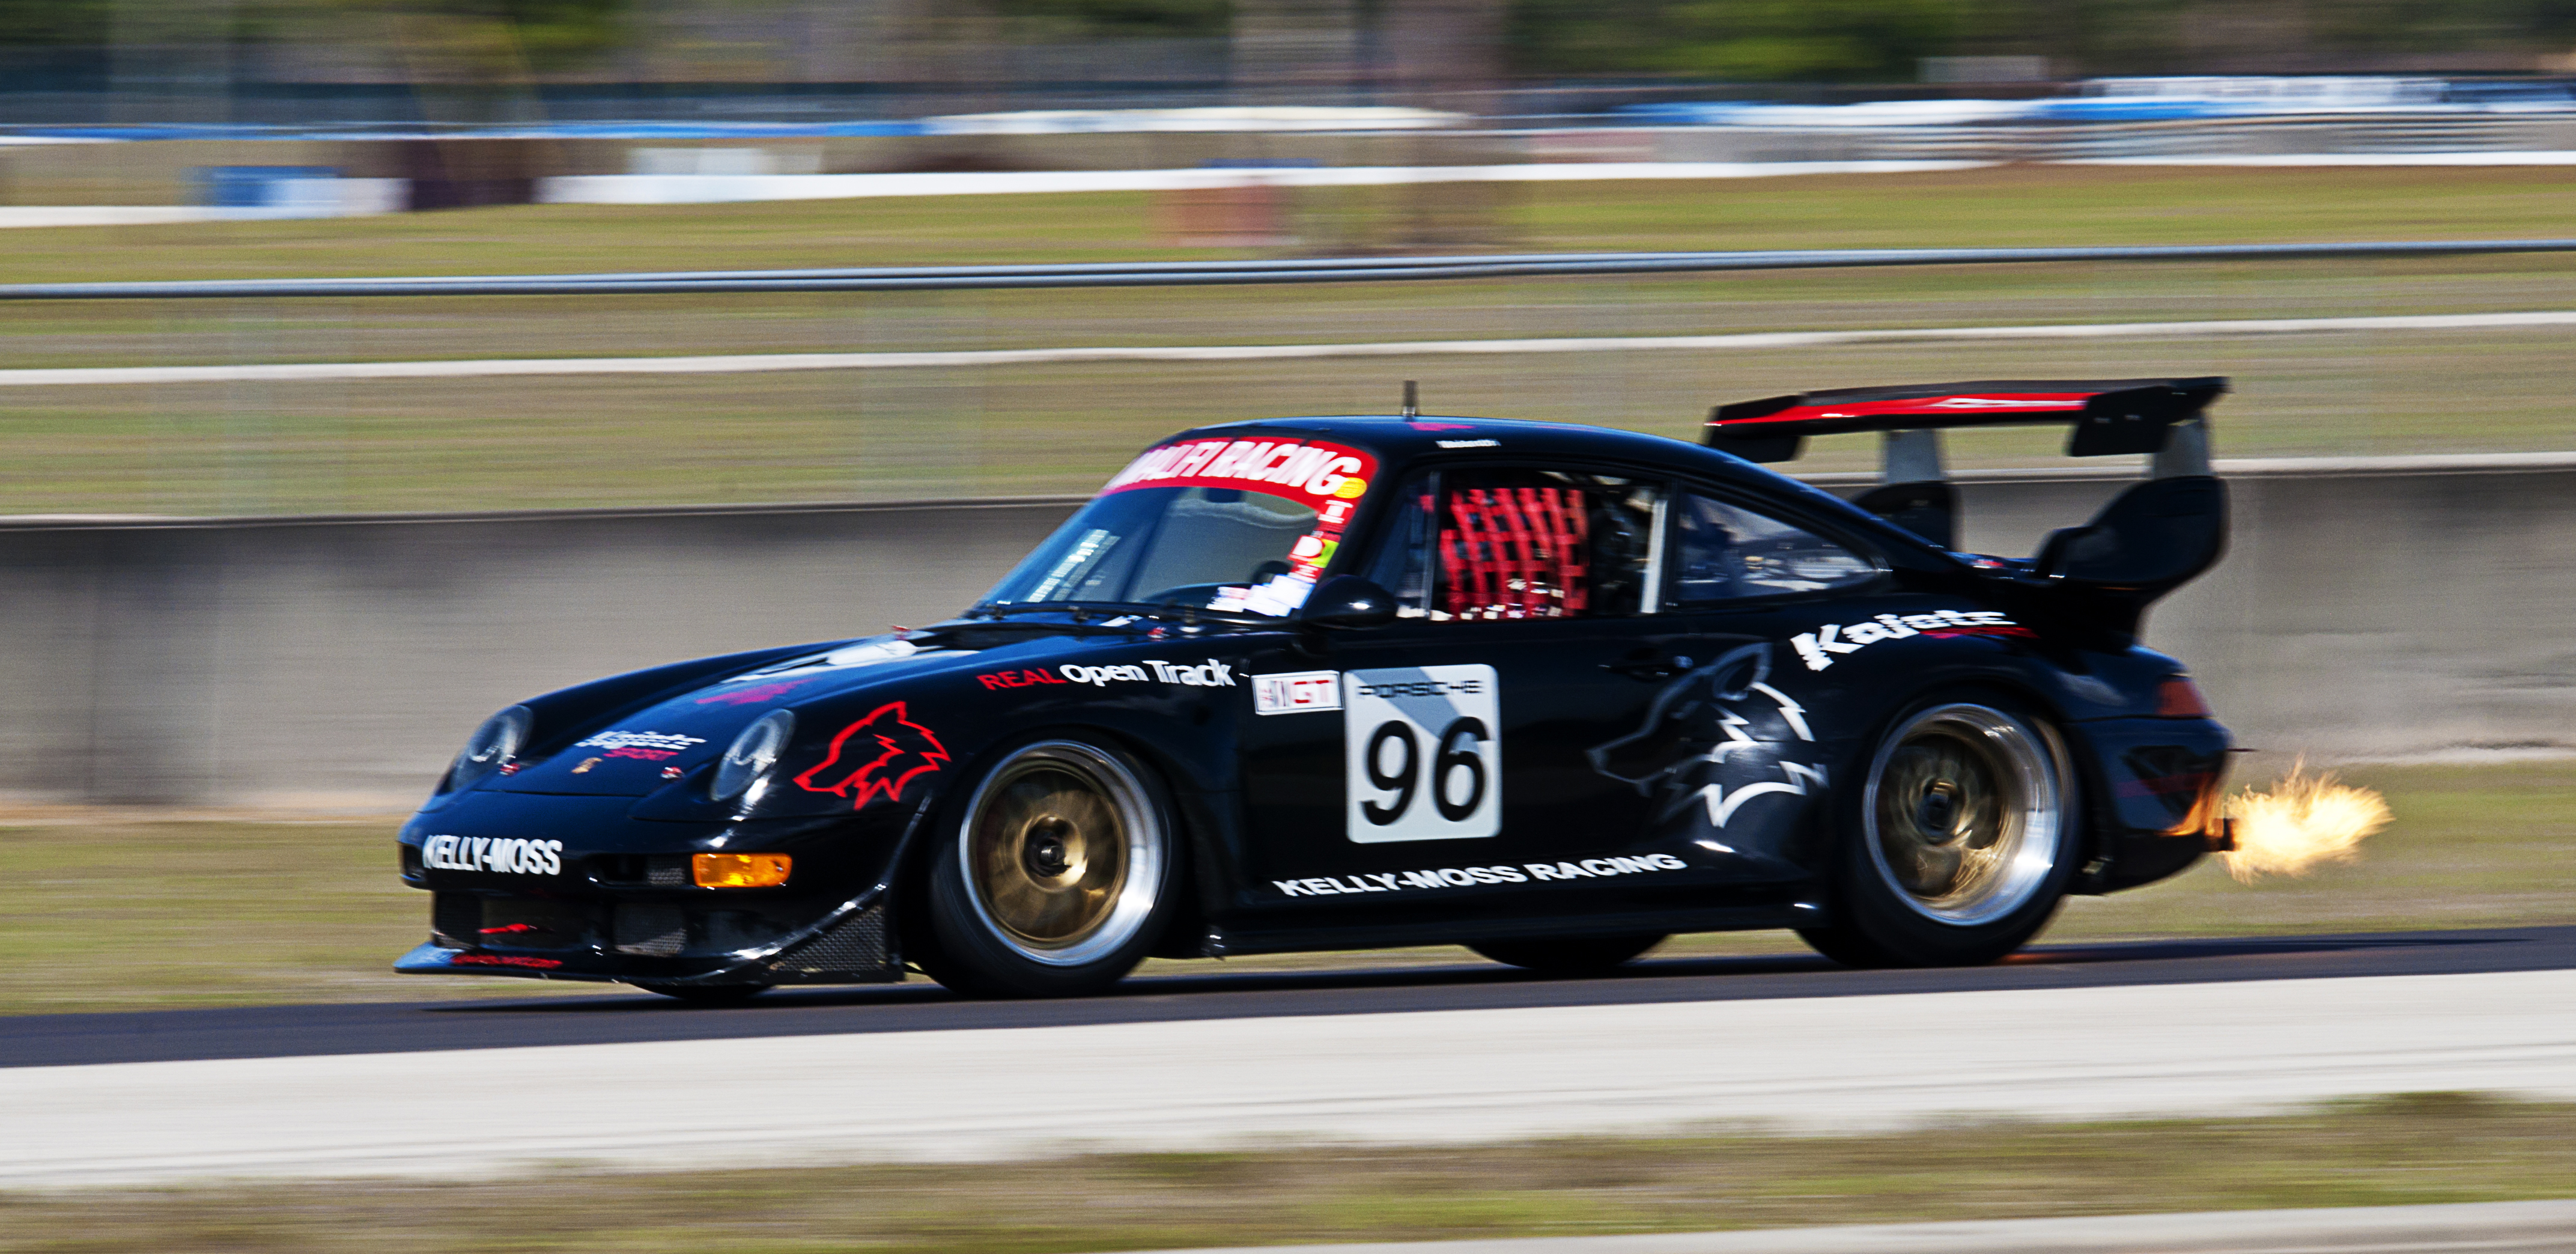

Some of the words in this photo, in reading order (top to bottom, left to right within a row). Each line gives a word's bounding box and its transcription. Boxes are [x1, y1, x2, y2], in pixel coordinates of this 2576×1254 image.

[1197, 440, 1362, 495] RACING
[1790, 610, 2018, 671] Kajets
[976, 668, 1068, 690] REAL
[1059, 664, 1149, 687] Open
[1143, 658, 1236, 687] Track
[1289, 680, 1334, 704] GT
[1356, 680, 1483, 699] PORSCHE
[1361, 716, 1490, 826] 96
[422, 835, 563, 875] KELLY-MOSS
[1272, 865, 1529, 897] KELLY-MOSS
[1523, 853, 1688, 881] RACING
